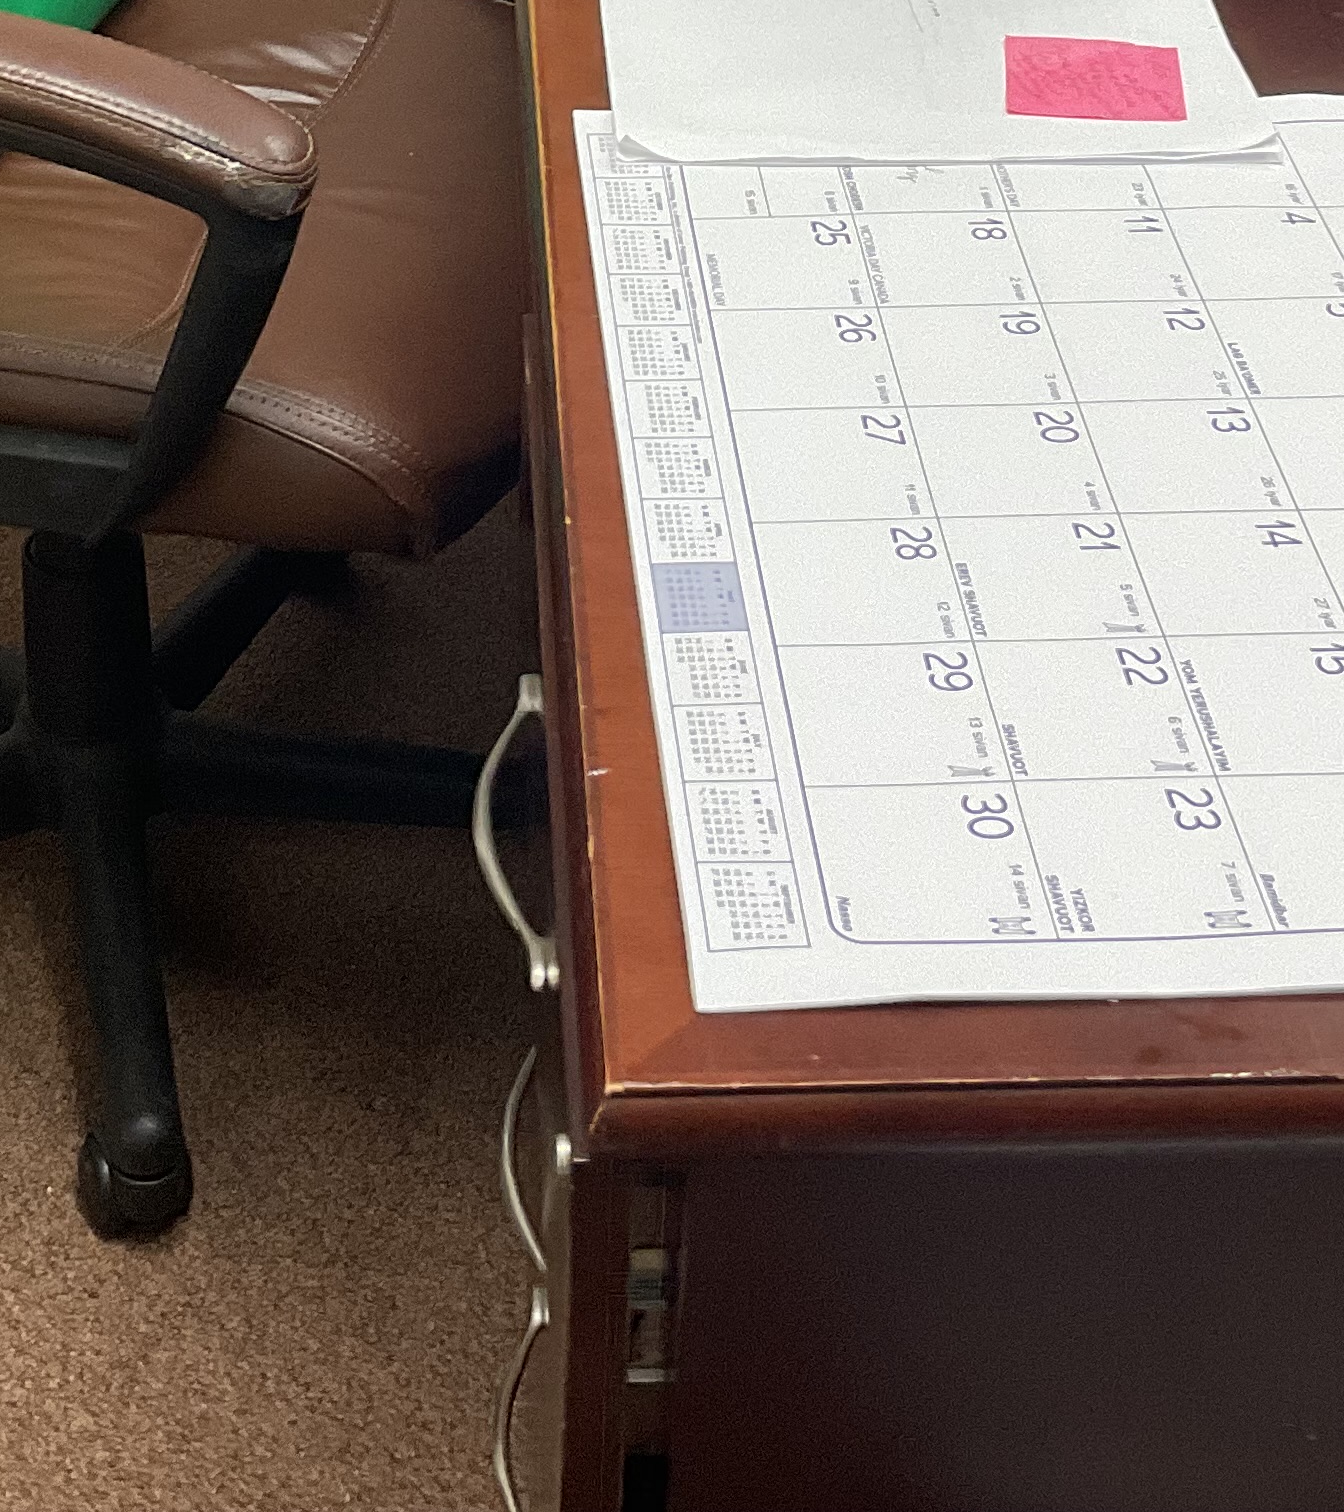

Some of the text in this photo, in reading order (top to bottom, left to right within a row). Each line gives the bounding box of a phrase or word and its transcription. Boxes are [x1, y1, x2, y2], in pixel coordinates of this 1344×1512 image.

[968, 218, 1007, 240] 18
[1124, 215, 1163, 233] 11
[1280, 211, 1316, 224] 4
[810, 220, 851, 246] 25
[834, 313, 876, 343] 26
[999, 311, 1040, 335] 19
[1163, 307, 1206, 331] 12
[860, 414, 906, 445] 27
[1033, 410, 1080, 443] 20
[1206, 406, 1252, 433] 13
[890, 526, 937, 560] 28
[1072, 522, 1121, 550] 21
[1255, 520, 1303, 548] 14
[955, 563, 987, 637] EREV SHAVUOT
[923, 651, 973, 691] 29
[1115, 646, 1168, 686] 22
[1180, 659, 1198, 684] YOM
[1002, 724, 1028, 776] SHAVUOT
[961, 794, 1014, 839] 30
[1165, 788, 1221, 830] 23
[1013, 880, 1031, 909] sivan
[1225, 873, 1244, 902] sivan
[1045, 875, 1074, 933] SHAVUOT
[1069, 888, 1095, 933] YIZKOR
